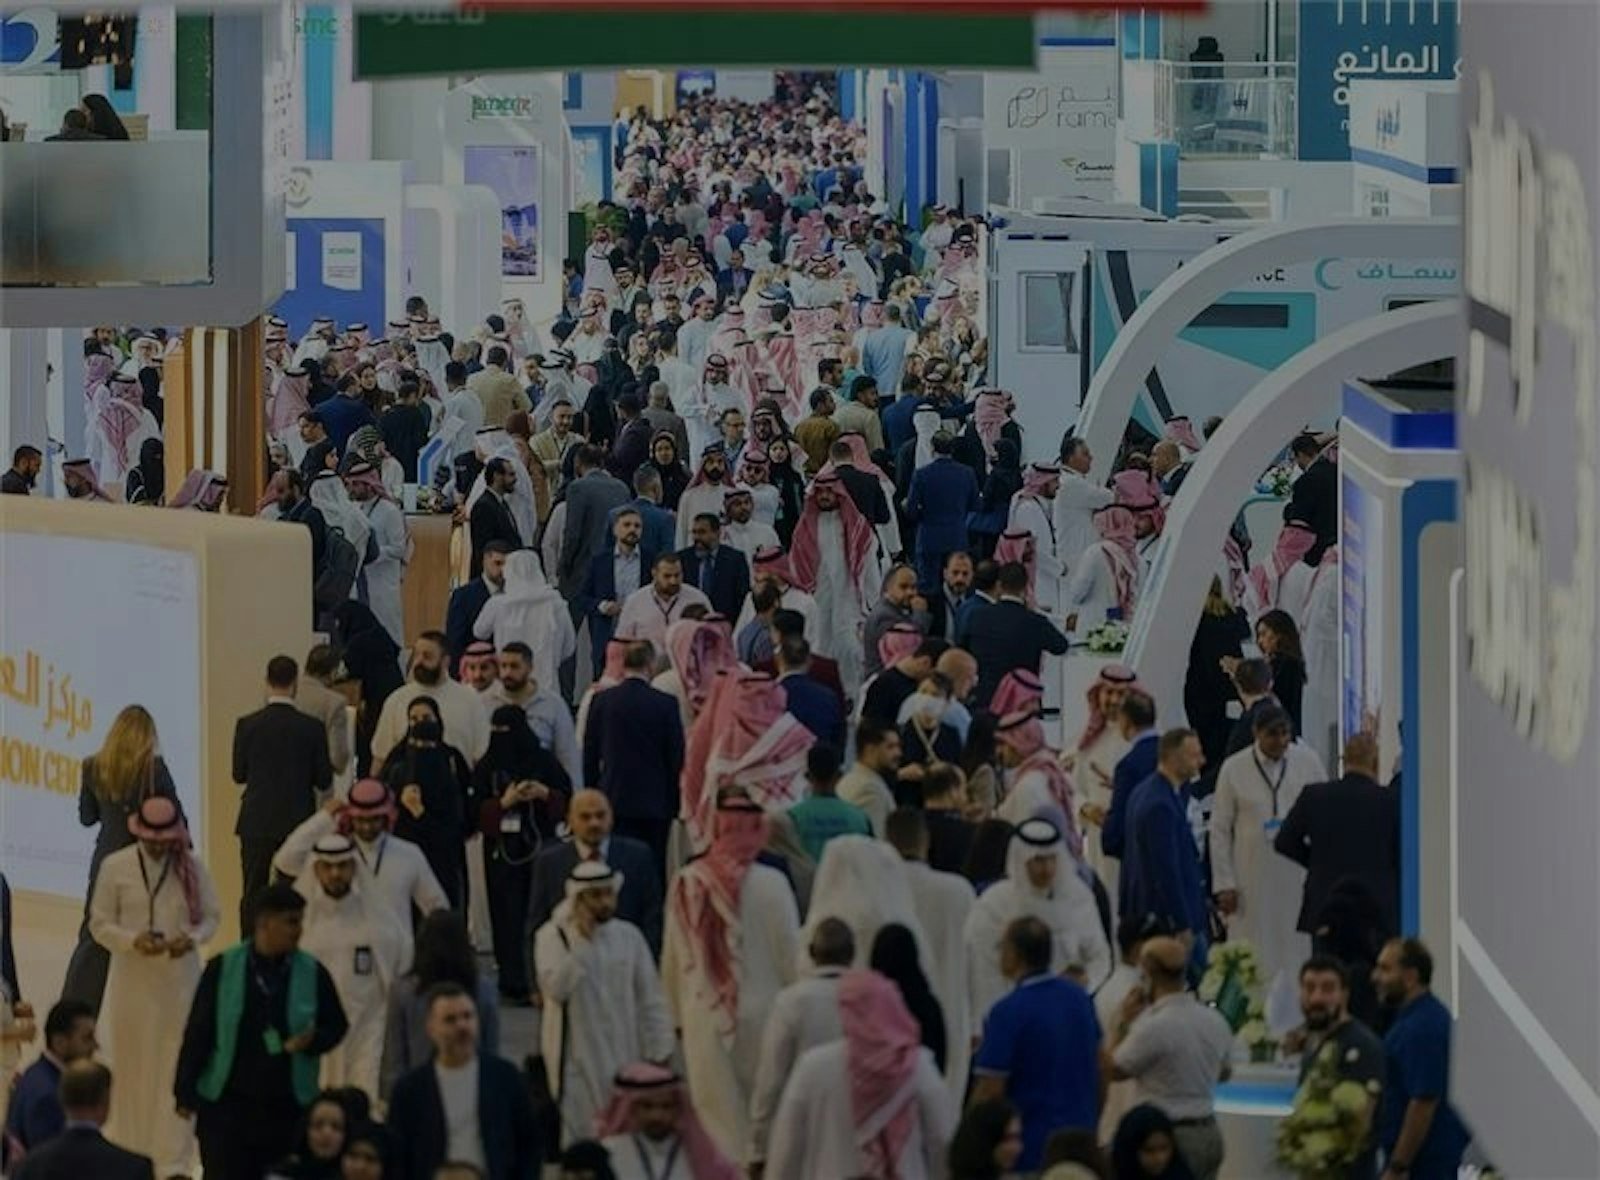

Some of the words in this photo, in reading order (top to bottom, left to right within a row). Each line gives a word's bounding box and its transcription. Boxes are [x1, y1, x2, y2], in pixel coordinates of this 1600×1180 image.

[1333, 44, 1440, 82] المانع
[1356, 263, 1457, 280] سعاف
[0, 735, 41, 787] ION
